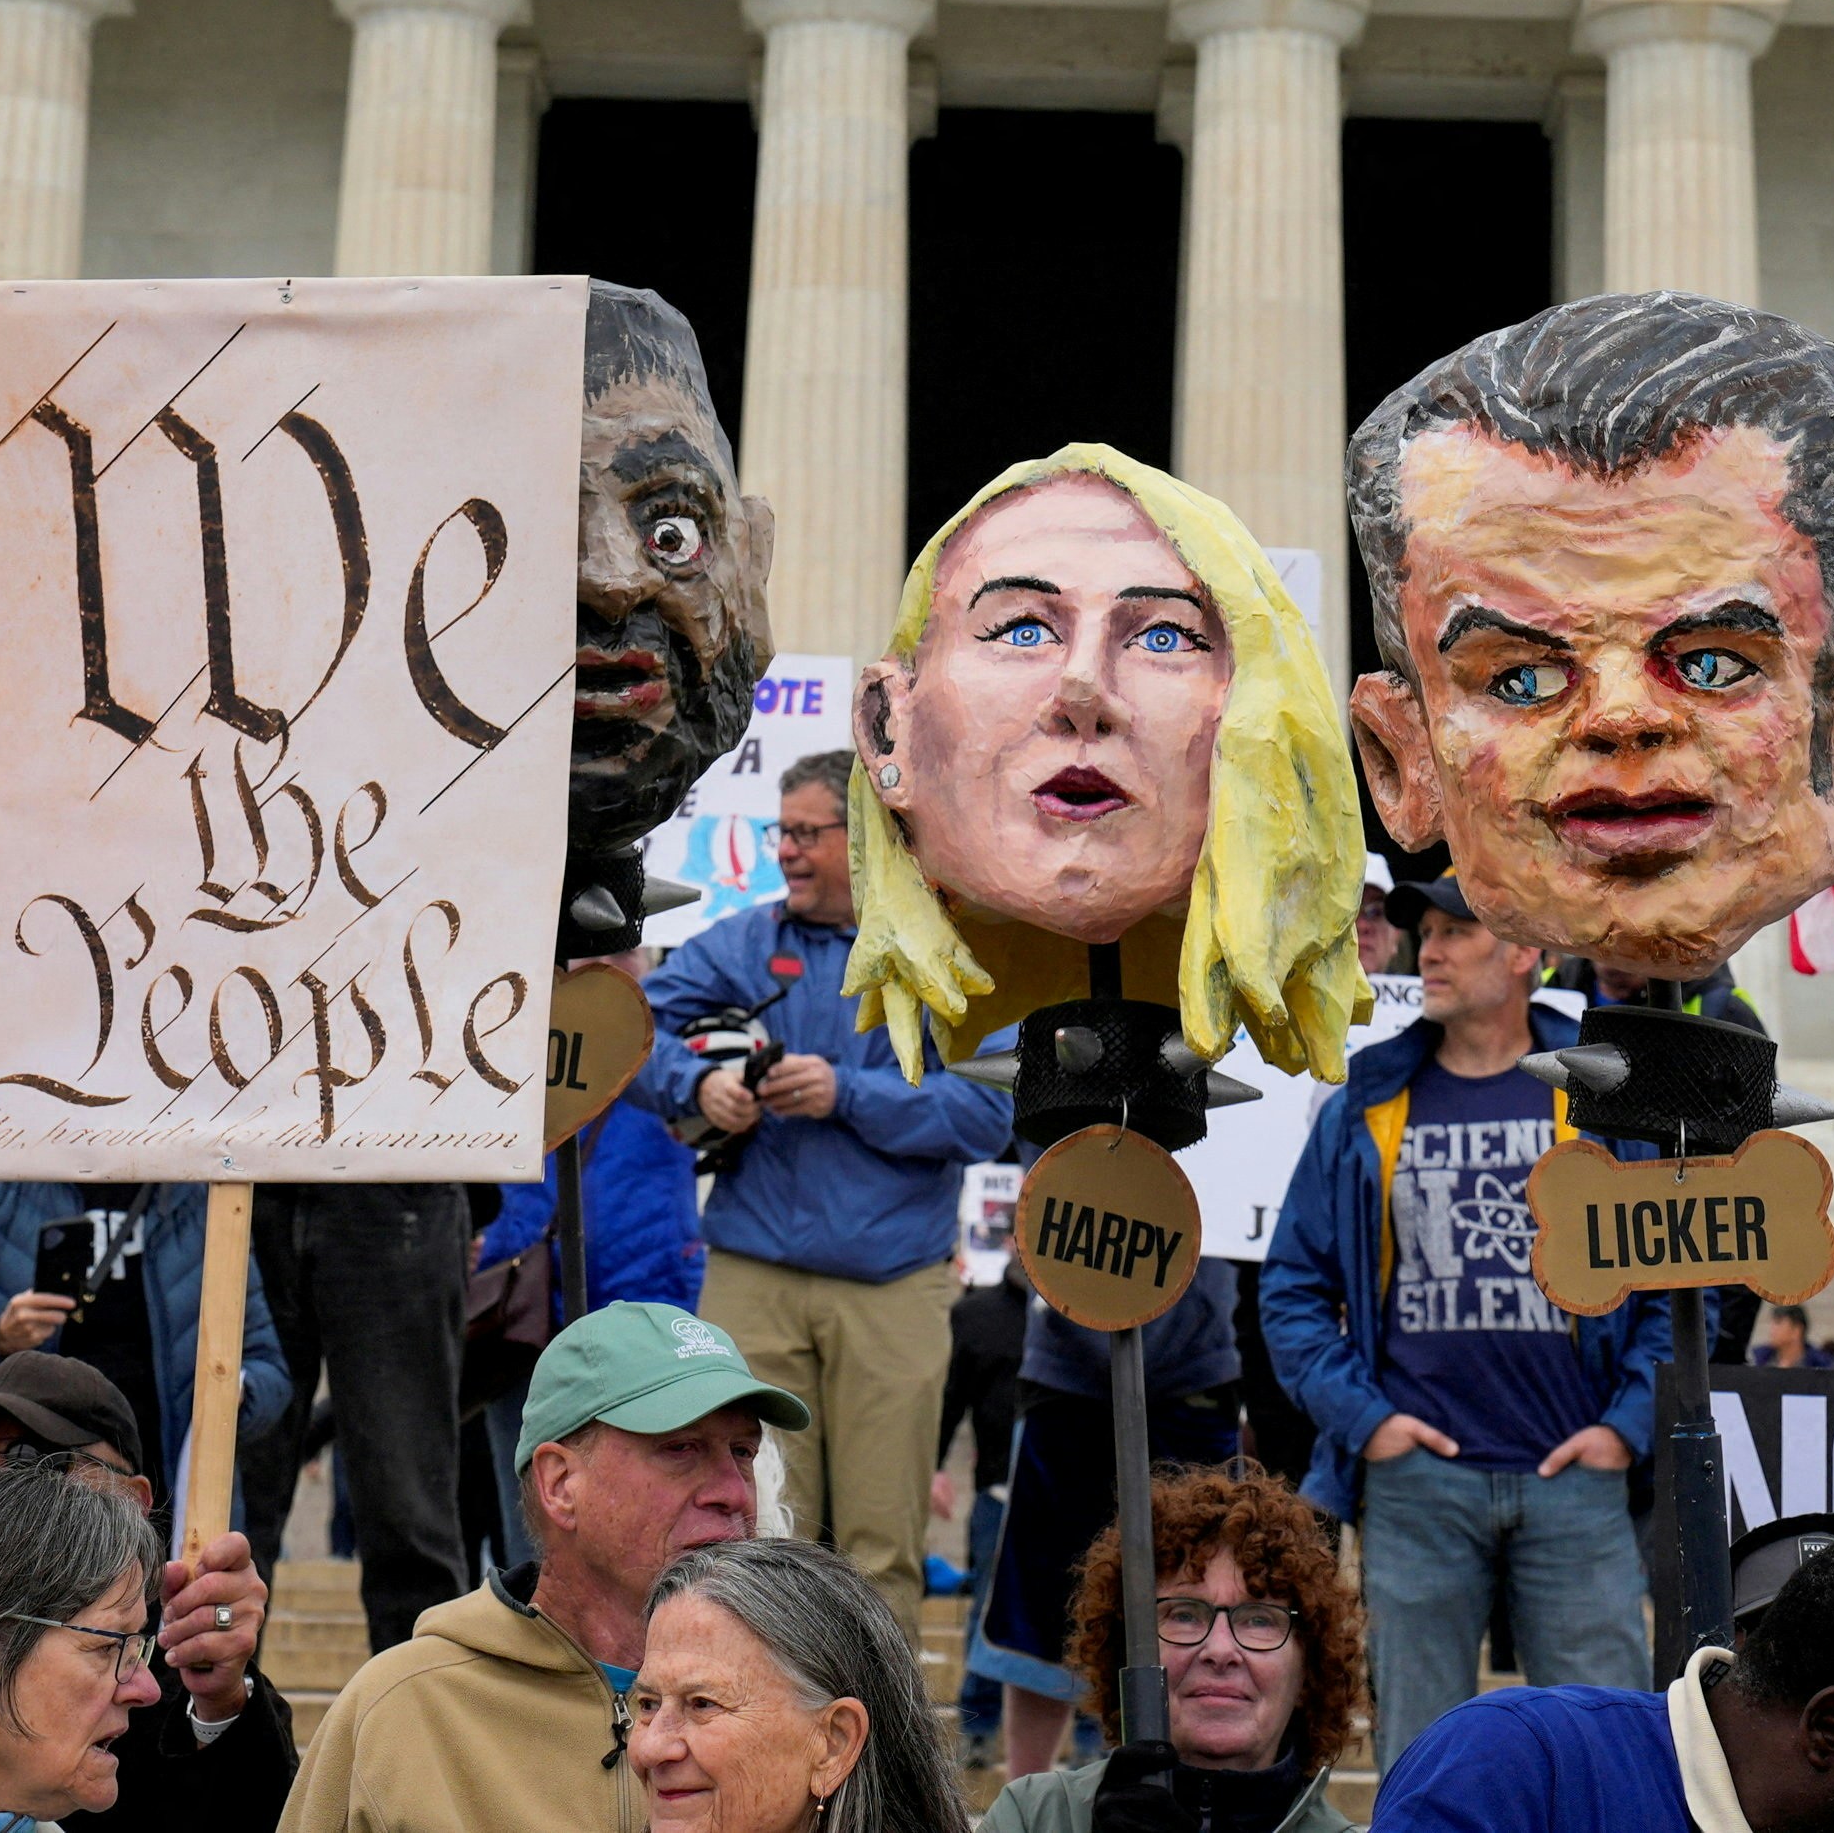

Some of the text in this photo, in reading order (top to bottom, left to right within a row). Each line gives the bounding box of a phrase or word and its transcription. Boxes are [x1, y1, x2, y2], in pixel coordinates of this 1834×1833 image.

[754, 677, 824, 716] OTE
[181, 721, 419, 934] the
[339, 1130, 521, 1150] common
[1036, 1197, 1183, 1288] HARPY
[1586, 1195, 1768, 1269] LICKER
